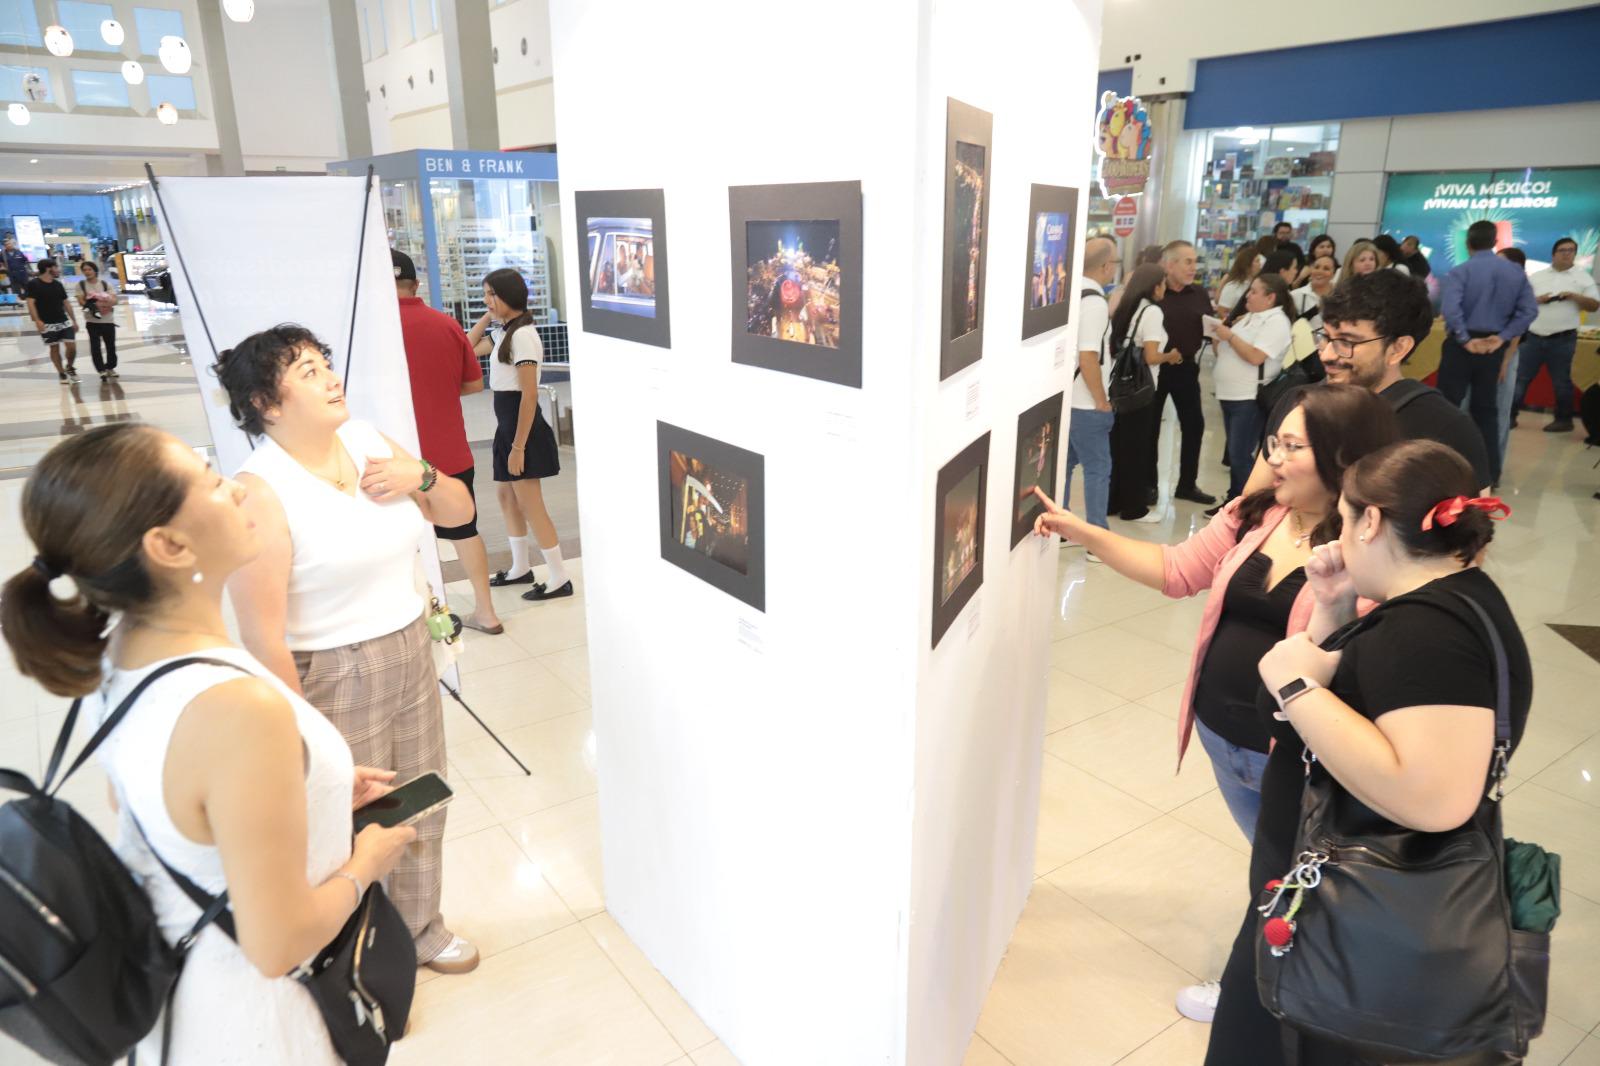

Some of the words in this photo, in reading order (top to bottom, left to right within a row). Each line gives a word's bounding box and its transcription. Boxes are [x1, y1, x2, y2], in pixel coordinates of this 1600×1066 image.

[425, 157, 453, 172] BEN
[461, 158, 471, 172] &
[479, 159, 524, 174] FRANK
[1434, 183, 1476, 198] ¡VIVA
[1479, 179, 1552, 196] MÉXICO!
[1423, 198, 1469, 210] ¡VIVAN
[1470, 197, 1499, 209] LOS
[1500, 196, 1559, 208] LIBROS!
